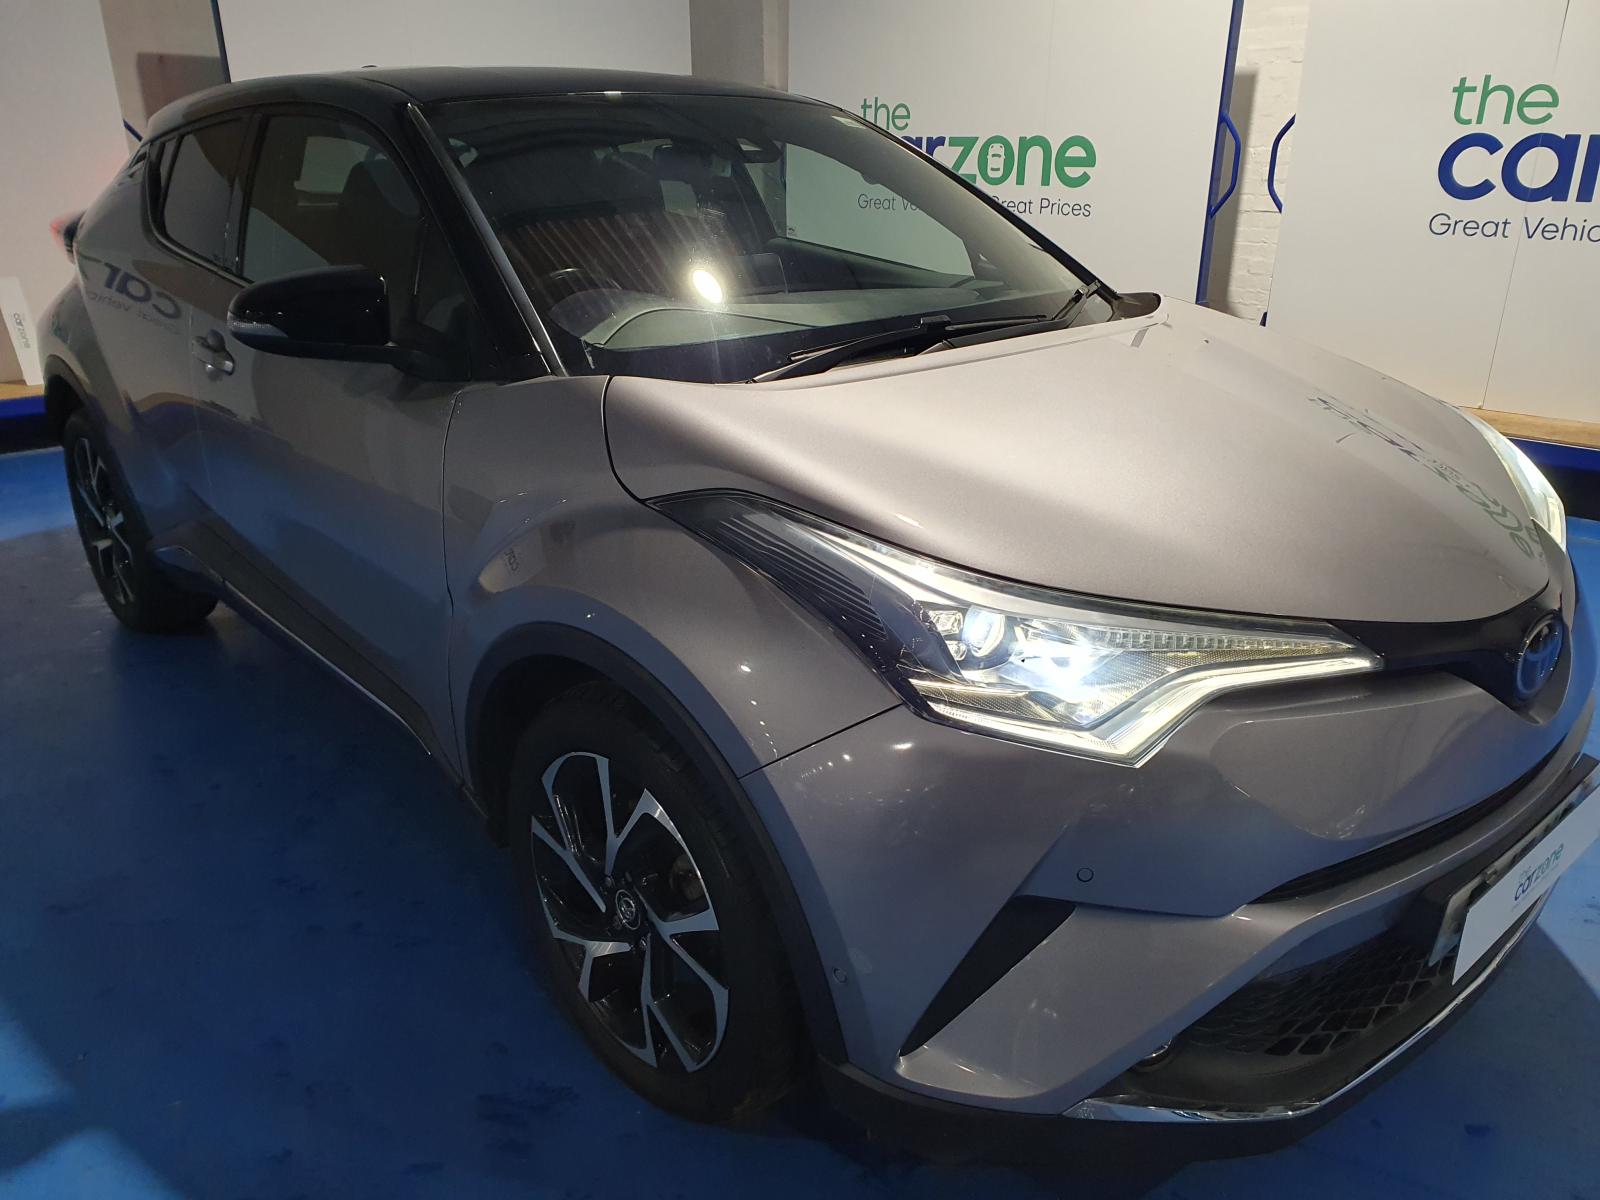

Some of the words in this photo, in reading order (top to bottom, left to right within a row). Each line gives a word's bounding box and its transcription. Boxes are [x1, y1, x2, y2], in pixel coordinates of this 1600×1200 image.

[861, 97, 910, 130] the
[1452, 74, 1560, 125] the
[857, 193, 897, 211] Great
[992, 195, 1033, 214] eat
[1040, 197, 1091, 217] Prices
[1428, 213, 1511, 238] Great
[1524, 216, 1600, 243] Vehic
[1514, 843, 1564, 901] carzone
